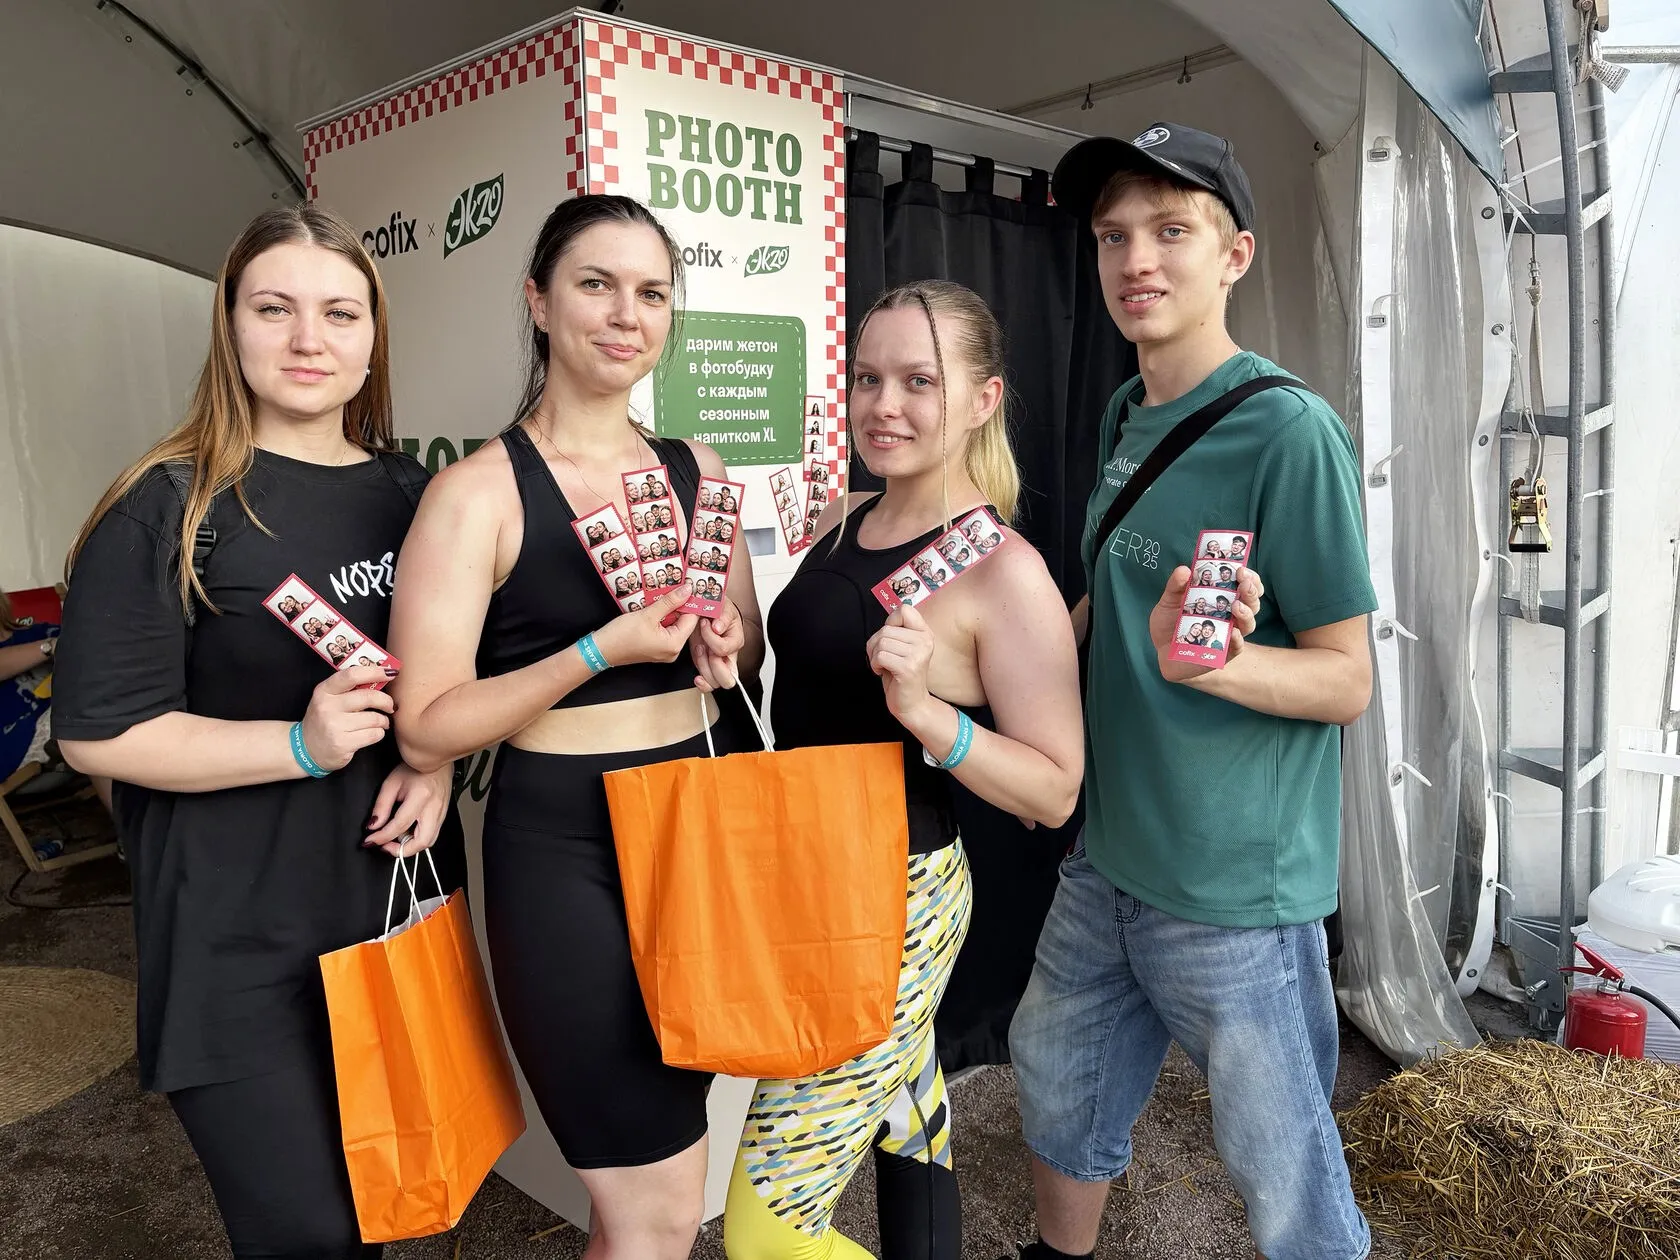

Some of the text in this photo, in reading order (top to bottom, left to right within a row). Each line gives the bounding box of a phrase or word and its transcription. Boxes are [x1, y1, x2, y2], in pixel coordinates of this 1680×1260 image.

[645, 109, 802, 177] PHOTO
[647, 162, 803, 225] BOOTH
[683, 242, 723, 268] ofix
[686, 338, 778, 355] дарим жетон
[689, 358, 774, 379] в фотобудку
[697, 386, 767, 400] с каждым
[699, 409, 770, 421] сезонным
[693, 427, 777, 444] напитком XL
[1144, 538, 1160, 556] 20
[1142, 552, 1158, 570] 25
